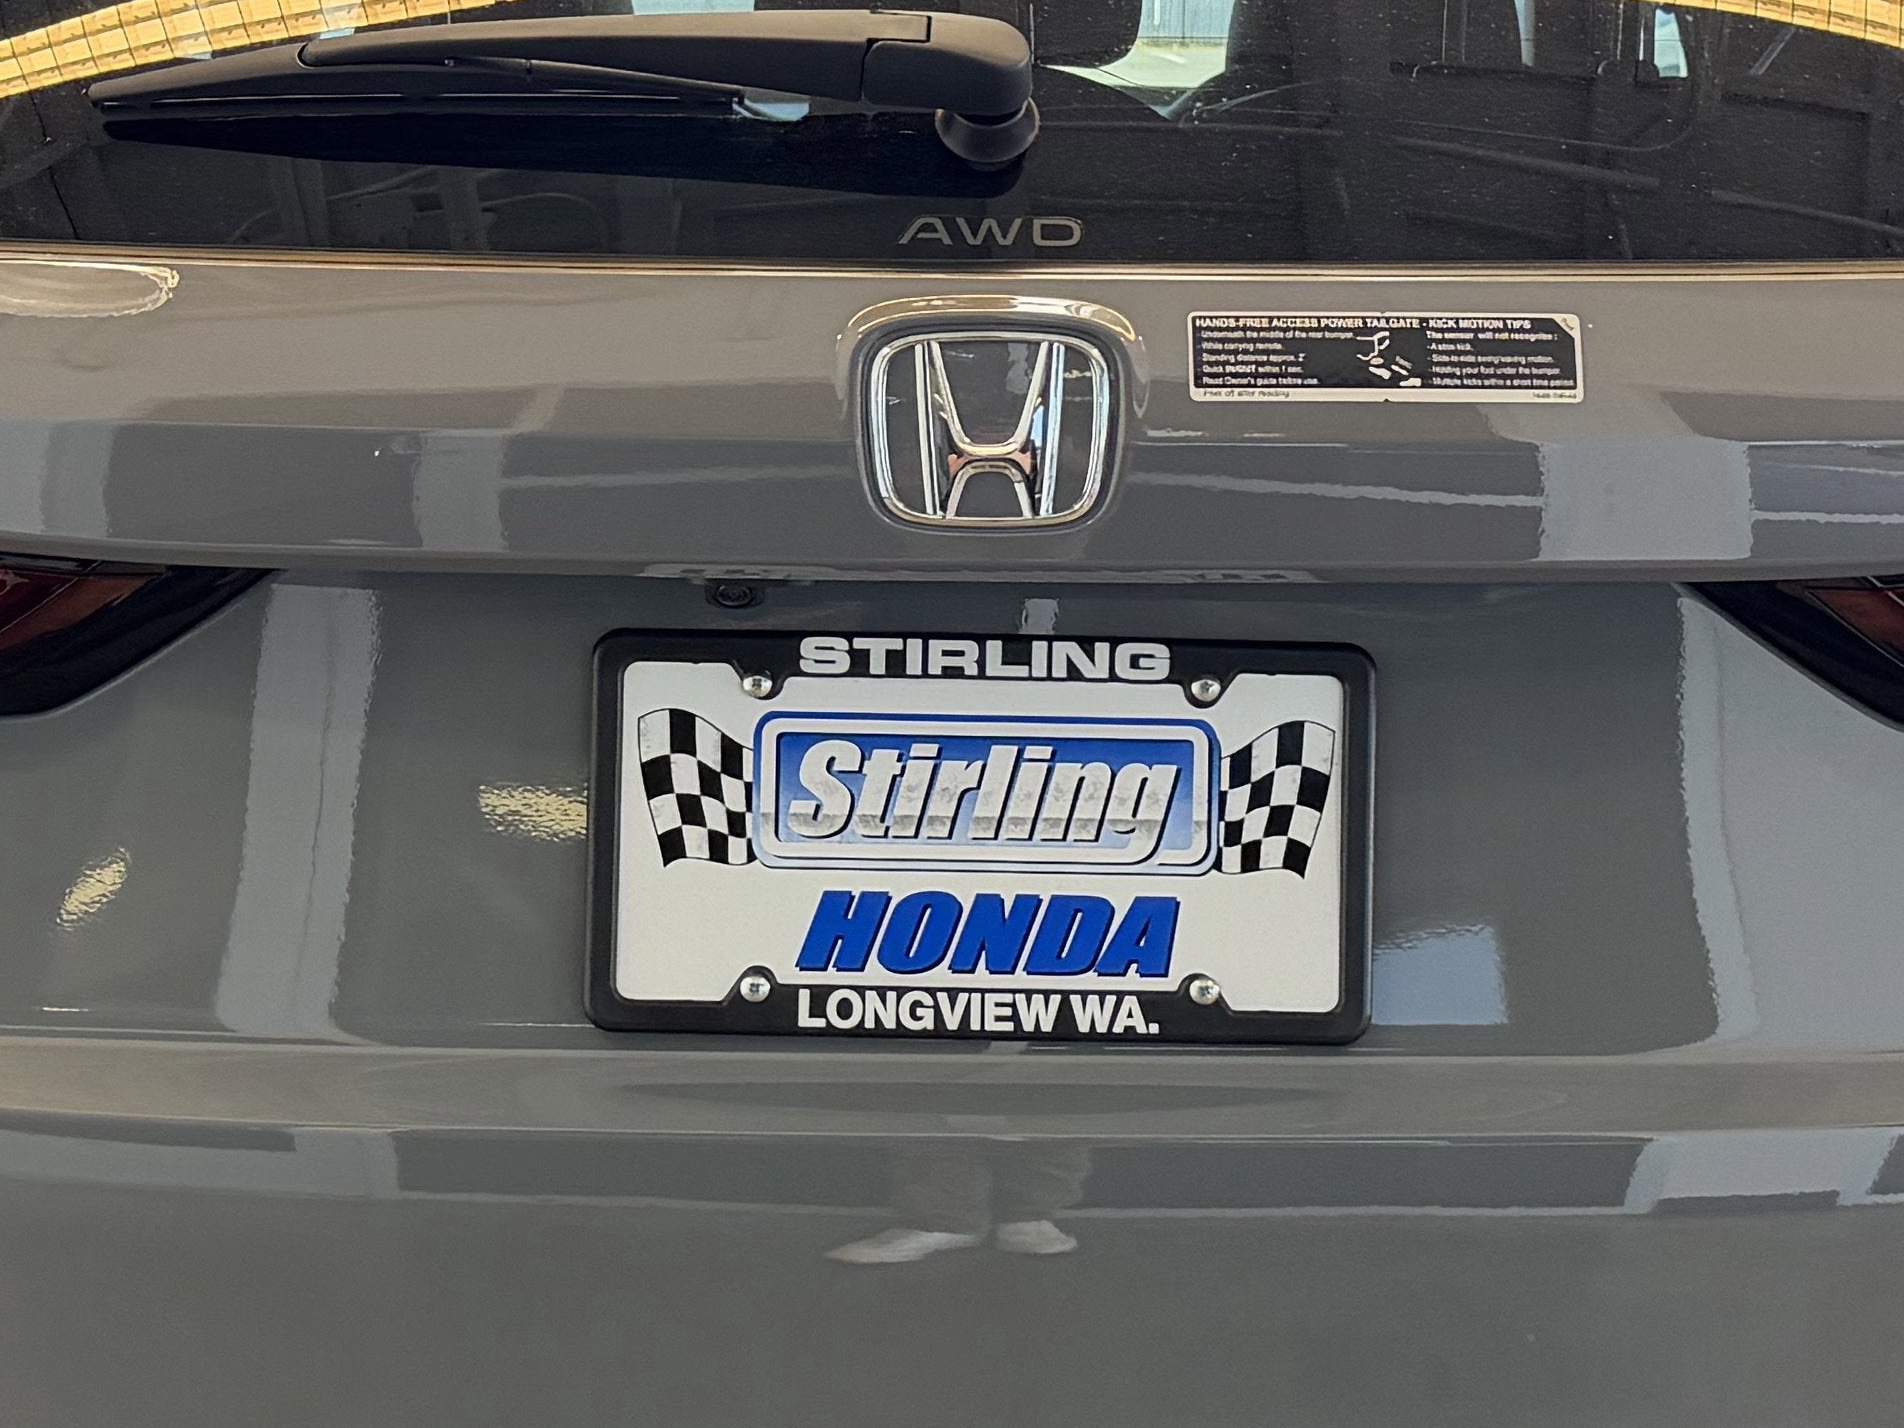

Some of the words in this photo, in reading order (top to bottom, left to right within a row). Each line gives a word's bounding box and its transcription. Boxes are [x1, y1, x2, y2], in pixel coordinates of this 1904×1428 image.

[897, 214, 1085, 248] AWD
[1320, 318, 1363, 328] POWER
[798, 636, 1171, 683] STIRLING
[787, 738, 1178, 859] Stirling
[795, 889, 1183, 979] HONDA
[797, 988, 1061, 1034] LONGVIEW
[1069, 991, 1160, 1035] WA.
